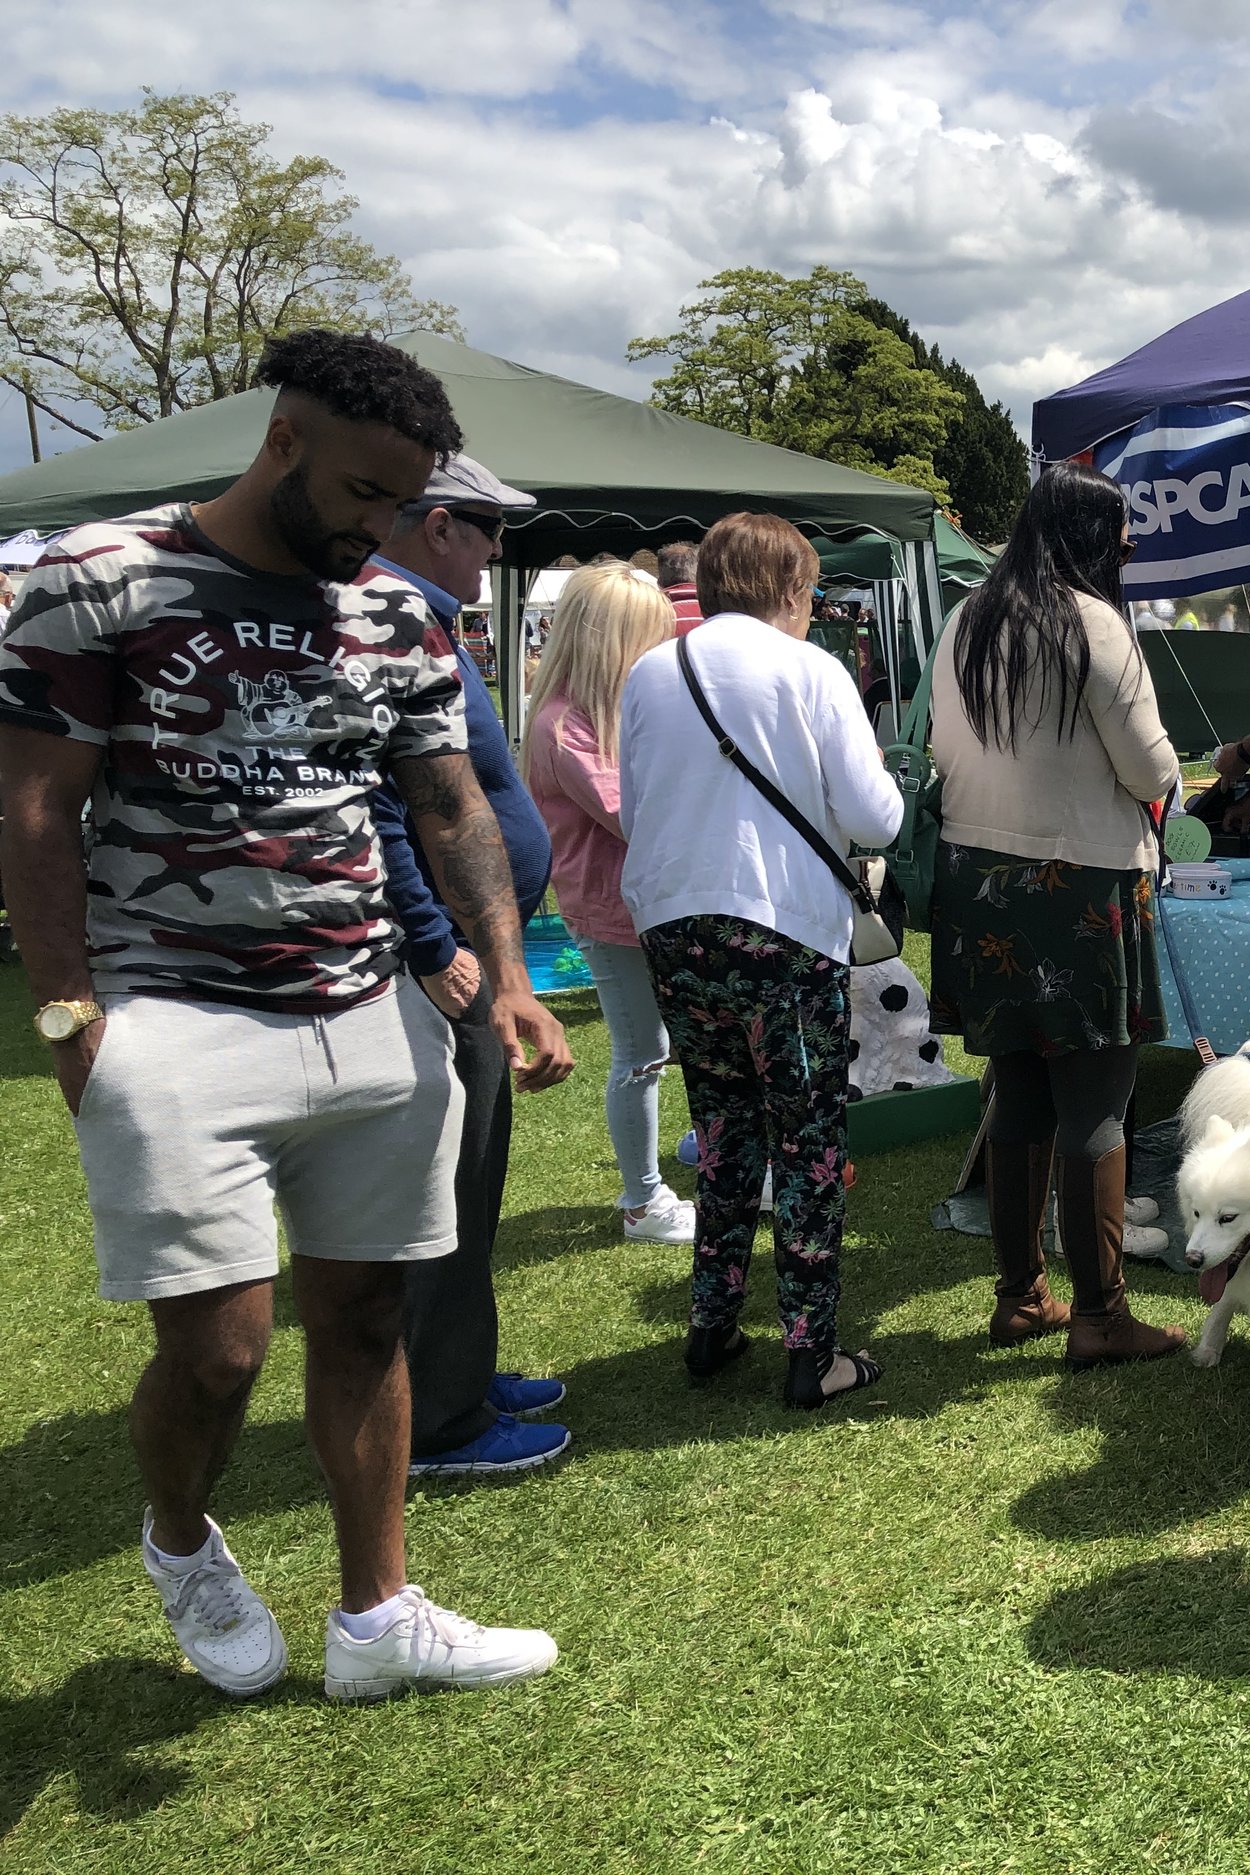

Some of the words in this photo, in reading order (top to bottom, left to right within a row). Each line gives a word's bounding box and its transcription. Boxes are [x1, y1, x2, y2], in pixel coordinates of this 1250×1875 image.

[150, 631, 224, 749] TRUE
[233, 621, 393, 760] RELIGION
[246, 746, 307, 761] THE
[156, 758, 285, 782] BUDDHA
[297, 766, 378, 785] BRAN
[242, 786, 280, 796] EST.
[285, 787, 324, 798] 2002
